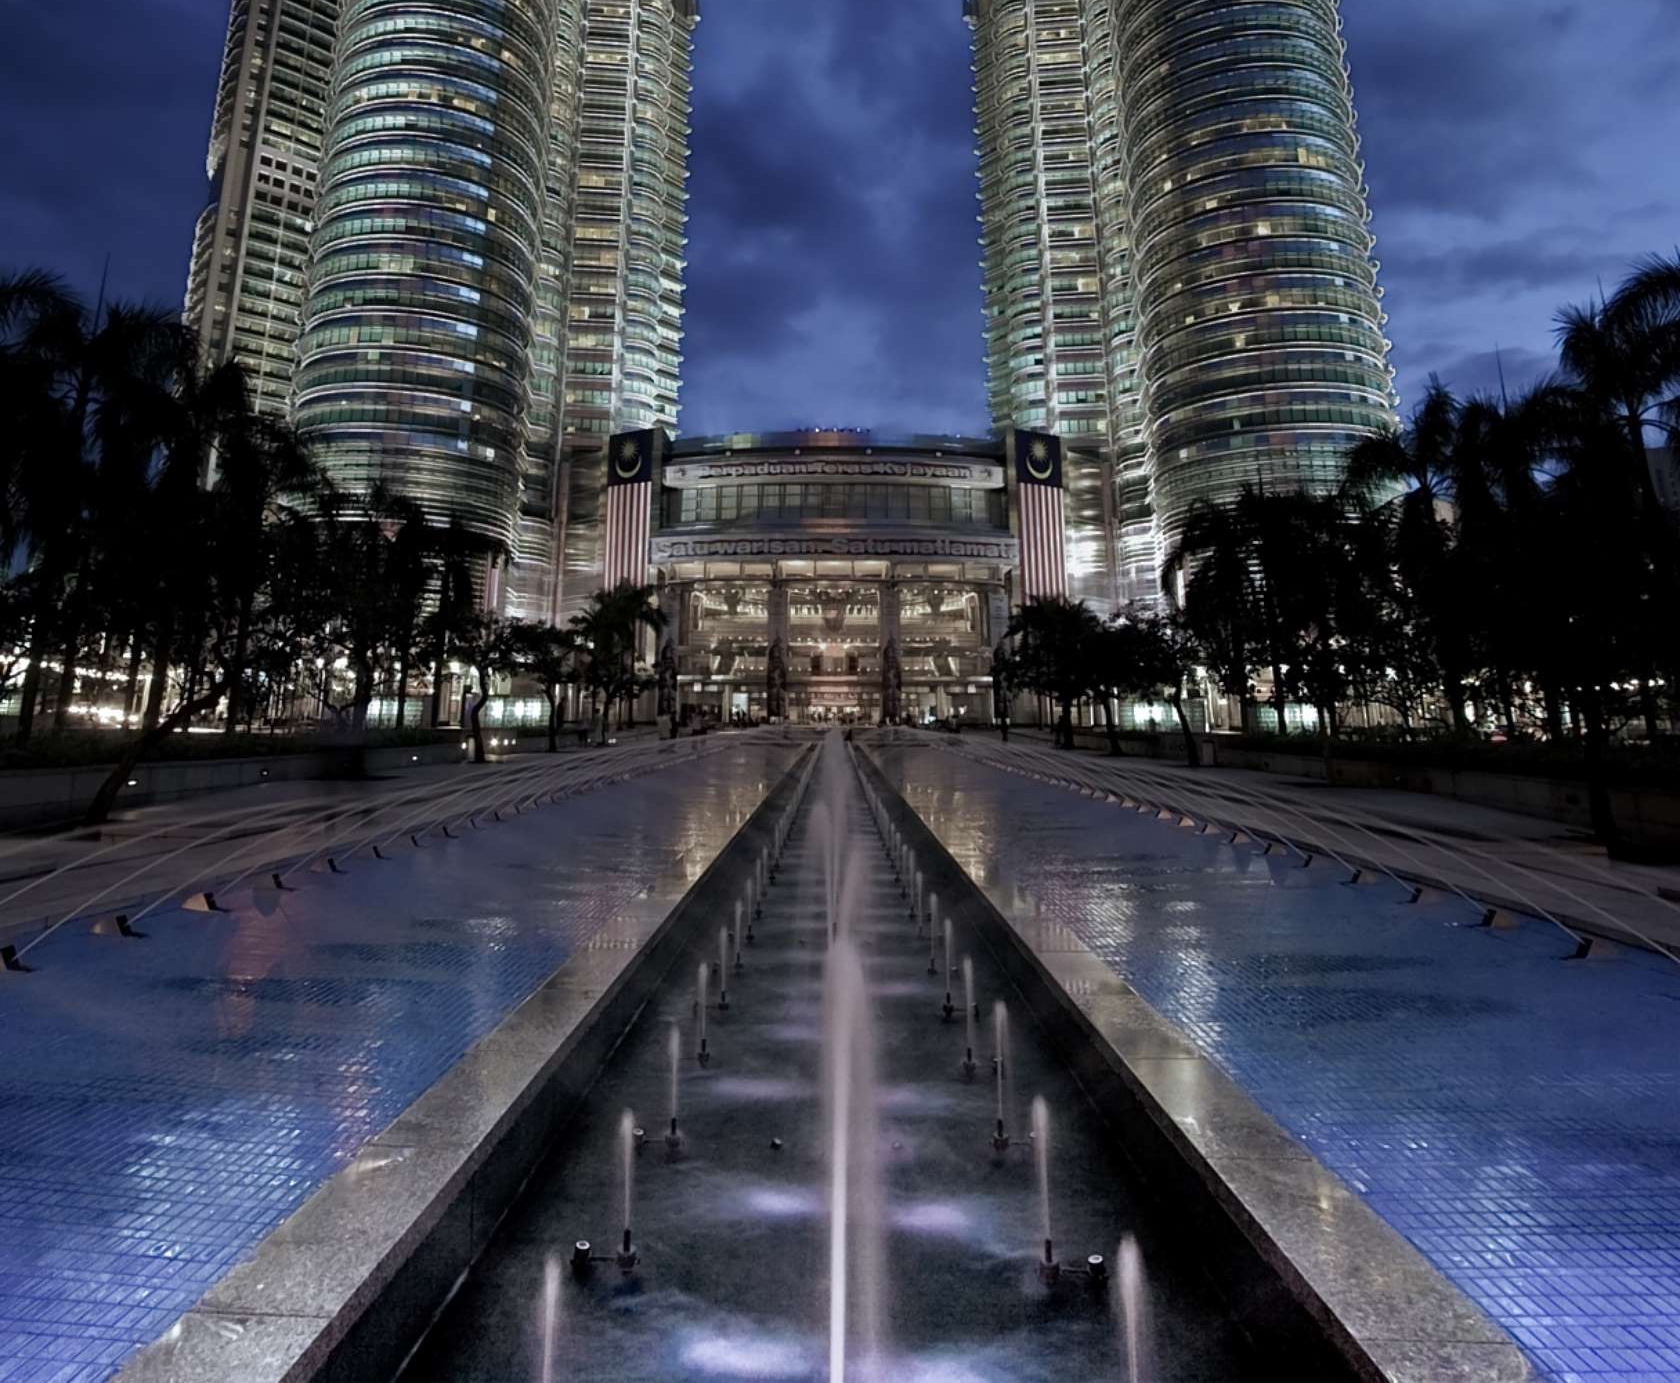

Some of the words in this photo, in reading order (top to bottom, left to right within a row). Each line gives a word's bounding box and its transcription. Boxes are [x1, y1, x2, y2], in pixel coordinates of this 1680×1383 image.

[699, 462, 808, 478] Perpaduan
[814, 462, 872, 475] Teras
[878, 462, 971, 479] Kejayaan
[658, 539, 711, 557] Satu
[831, 537, 891, 555] Satu
